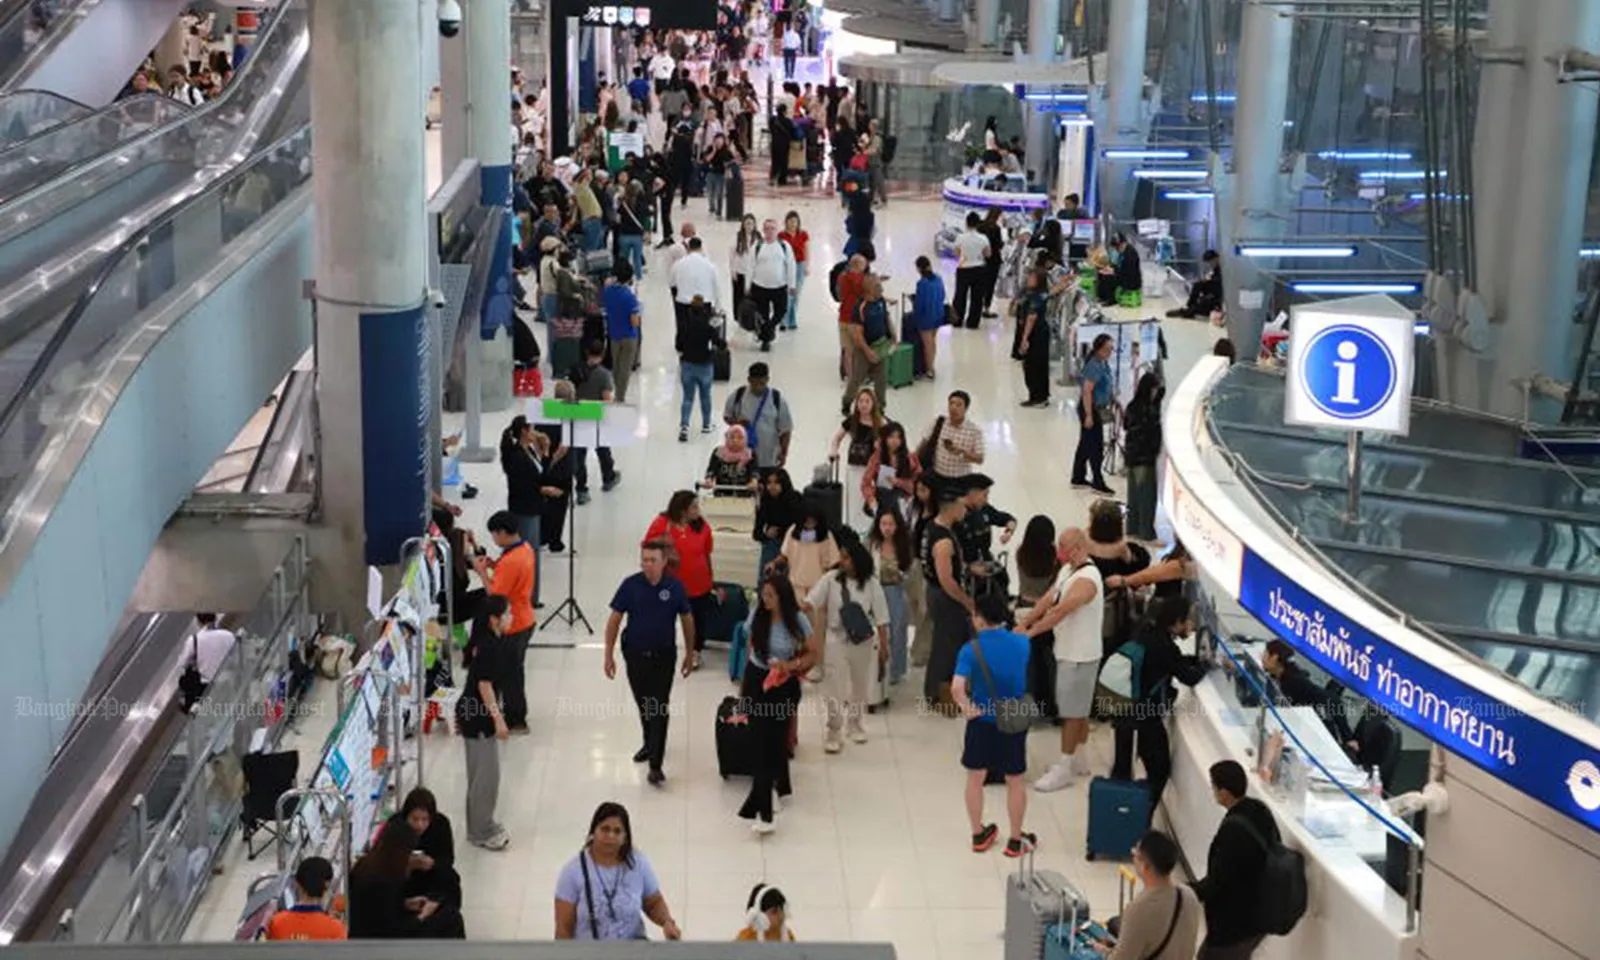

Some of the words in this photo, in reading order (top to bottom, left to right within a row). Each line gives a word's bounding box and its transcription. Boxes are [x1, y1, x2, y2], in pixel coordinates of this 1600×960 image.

[1268, 586, 1375, 682] ประชาสัมพันธ์
[1376, 658, 1517, 766] ท่าอากาศยาน
